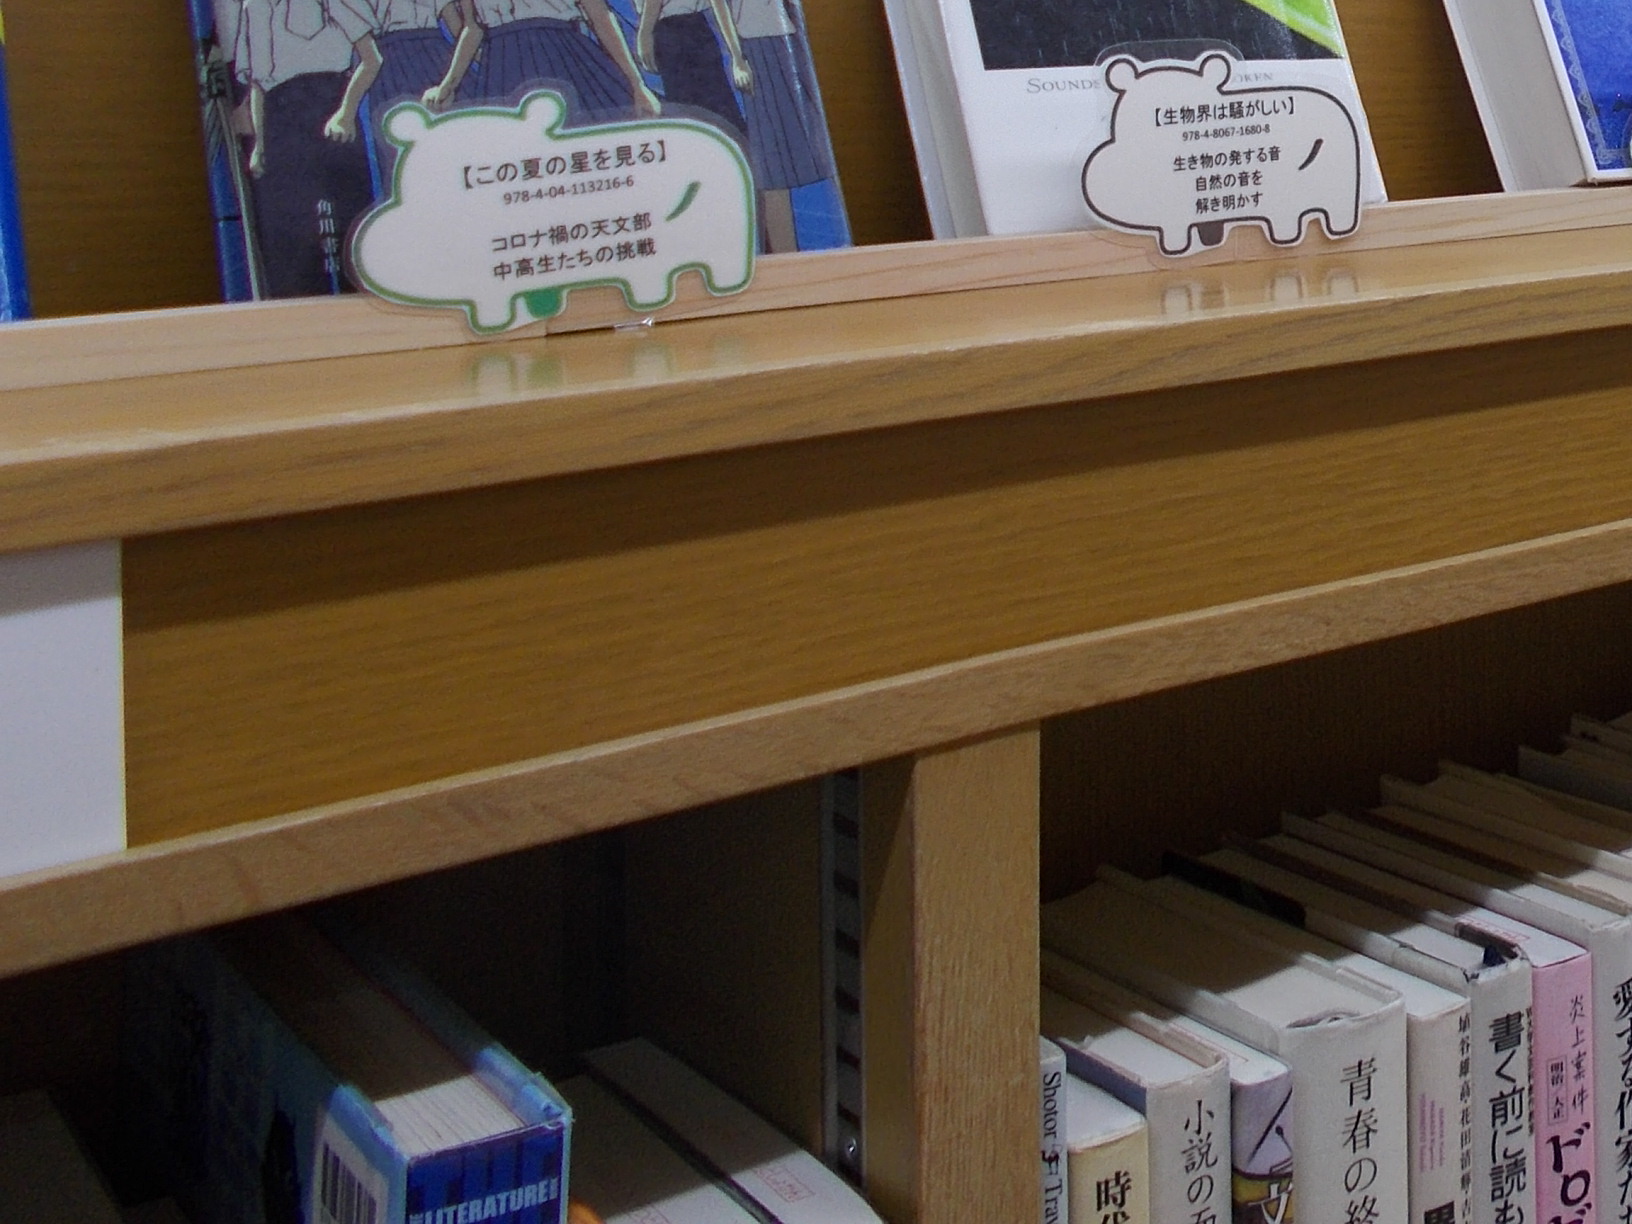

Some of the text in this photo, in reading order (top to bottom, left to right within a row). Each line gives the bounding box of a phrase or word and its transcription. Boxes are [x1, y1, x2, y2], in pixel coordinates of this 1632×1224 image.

[1153, 95, 1297, 128] 【生物界は騒がしい】
[1181, 123, 1271, 143] 978-4-8067-1680-8
[461, 139, 668, 190] 【この夏の星を見る】
[1172, 145, 1282, 173] 生き物の発する音
[502, 174, 635, 206] 978-4-04-113216-6
[1194, 169, 1264, 192] 自然の音を
[1194, 191, 1264, 216] 解き明かす
[491, 211, 653, 252] コロナ禍の天文部
[492, 236, 658, 281] 中高生たちの挑戦
[1569, 993, 1589, 1116] 炎上案件
